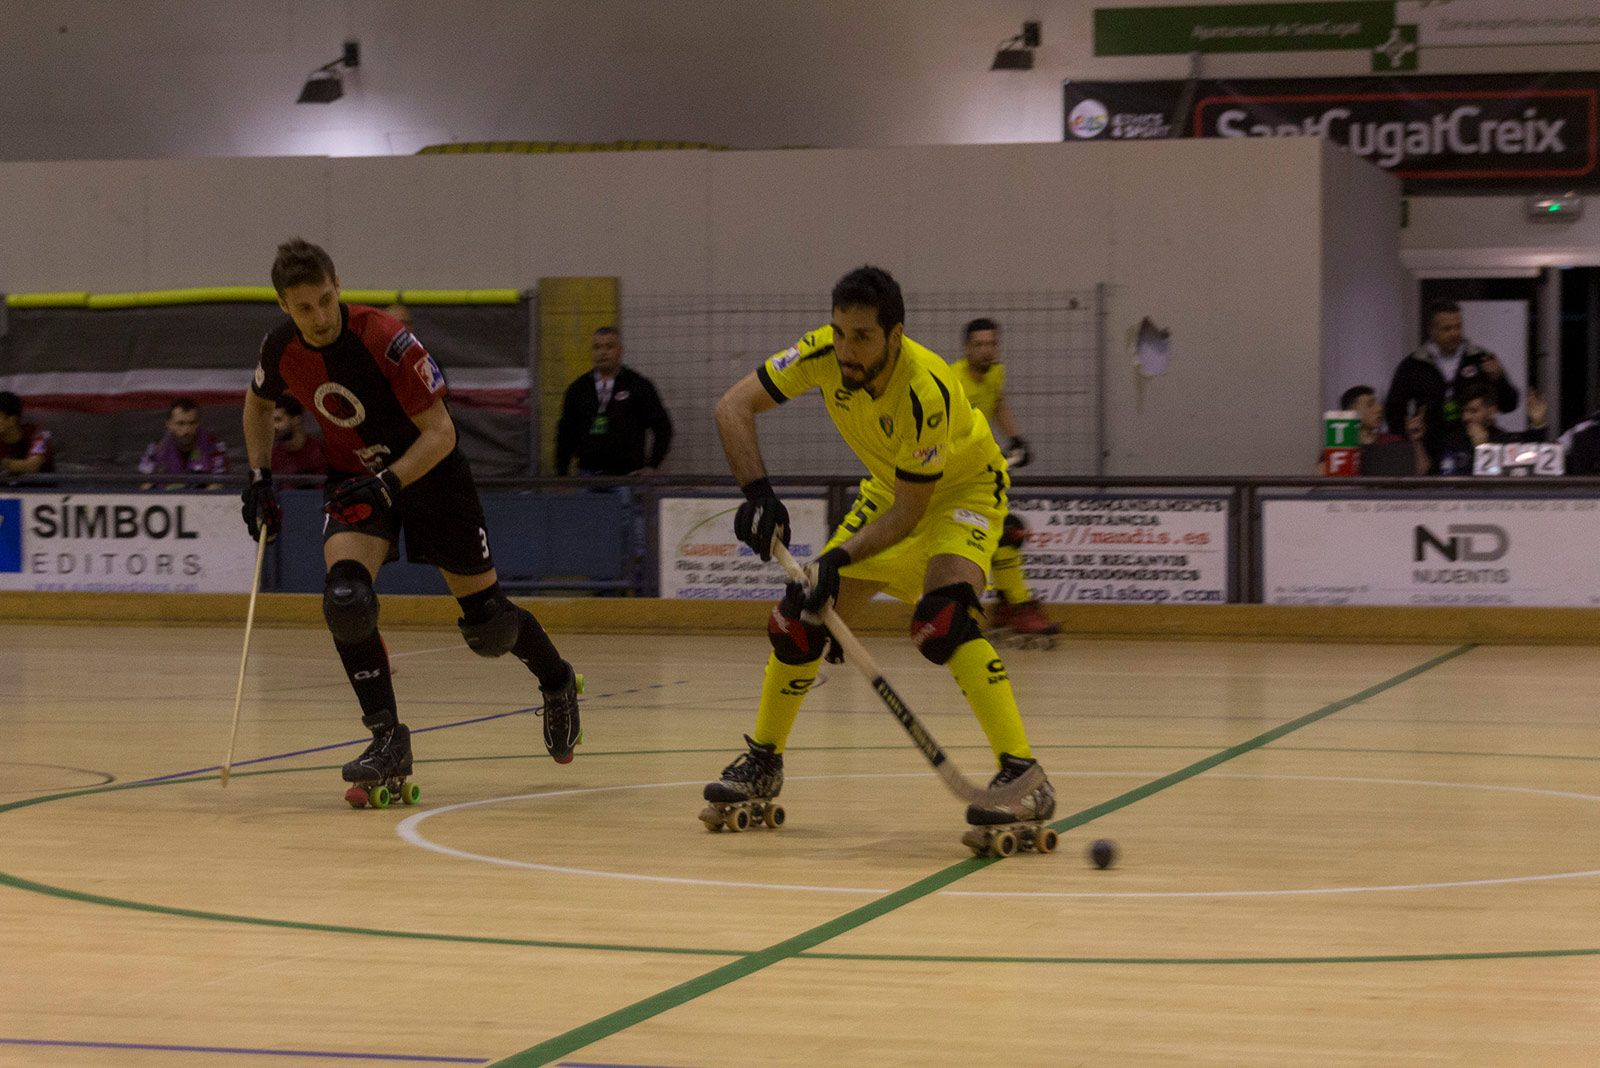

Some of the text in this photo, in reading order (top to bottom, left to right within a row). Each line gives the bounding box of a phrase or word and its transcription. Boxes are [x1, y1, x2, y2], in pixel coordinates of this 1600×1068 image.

[1329, 422, 1350, 444] T
[1328, 450, 1349, 474] F
[1542, 448, 1556, 471] 2
[32, 497, 199, 539] SÍMBOL
[1047, 514, 1161, 526] A DISTANCIA
[478, 526, 490, 559] 3
[32, 553, 202, 576] EDITORS
[1021, 554, 1188, 567] ENDA DE RECANVIS
[704, 573, 739, 587] Cugat
[1022, 568, 1201, 581] ELECTRODOMESTICS
[1412, 569, 1511, 585] NUDENTIS
[724, 587, 785, 599] CONCERT
